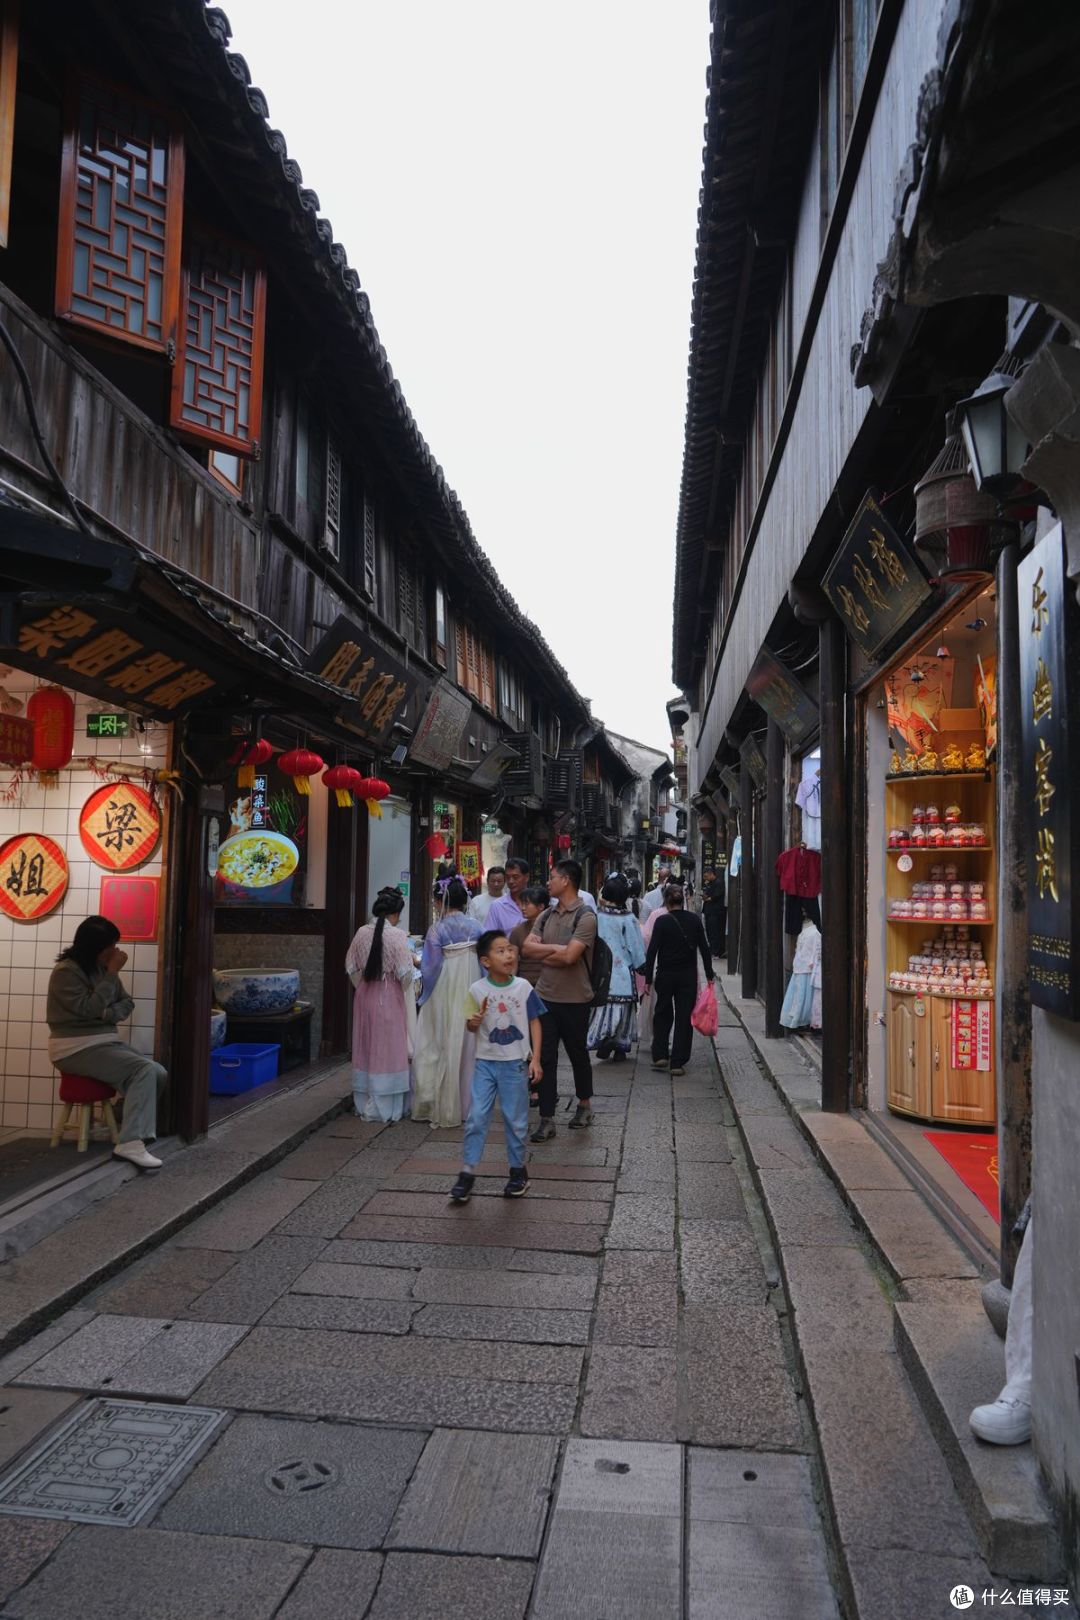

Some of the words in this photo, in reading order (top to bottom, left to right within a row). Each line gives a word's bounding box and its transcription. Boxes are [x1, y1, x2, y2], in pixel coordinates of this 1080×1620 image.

[17, 603, 216, 711] 梁姐剁椒
[97, 800, 142, 852] 梁
[253, 777, 265, 825] 酸菜鱼
[6, 849, 49, 898] 姐
